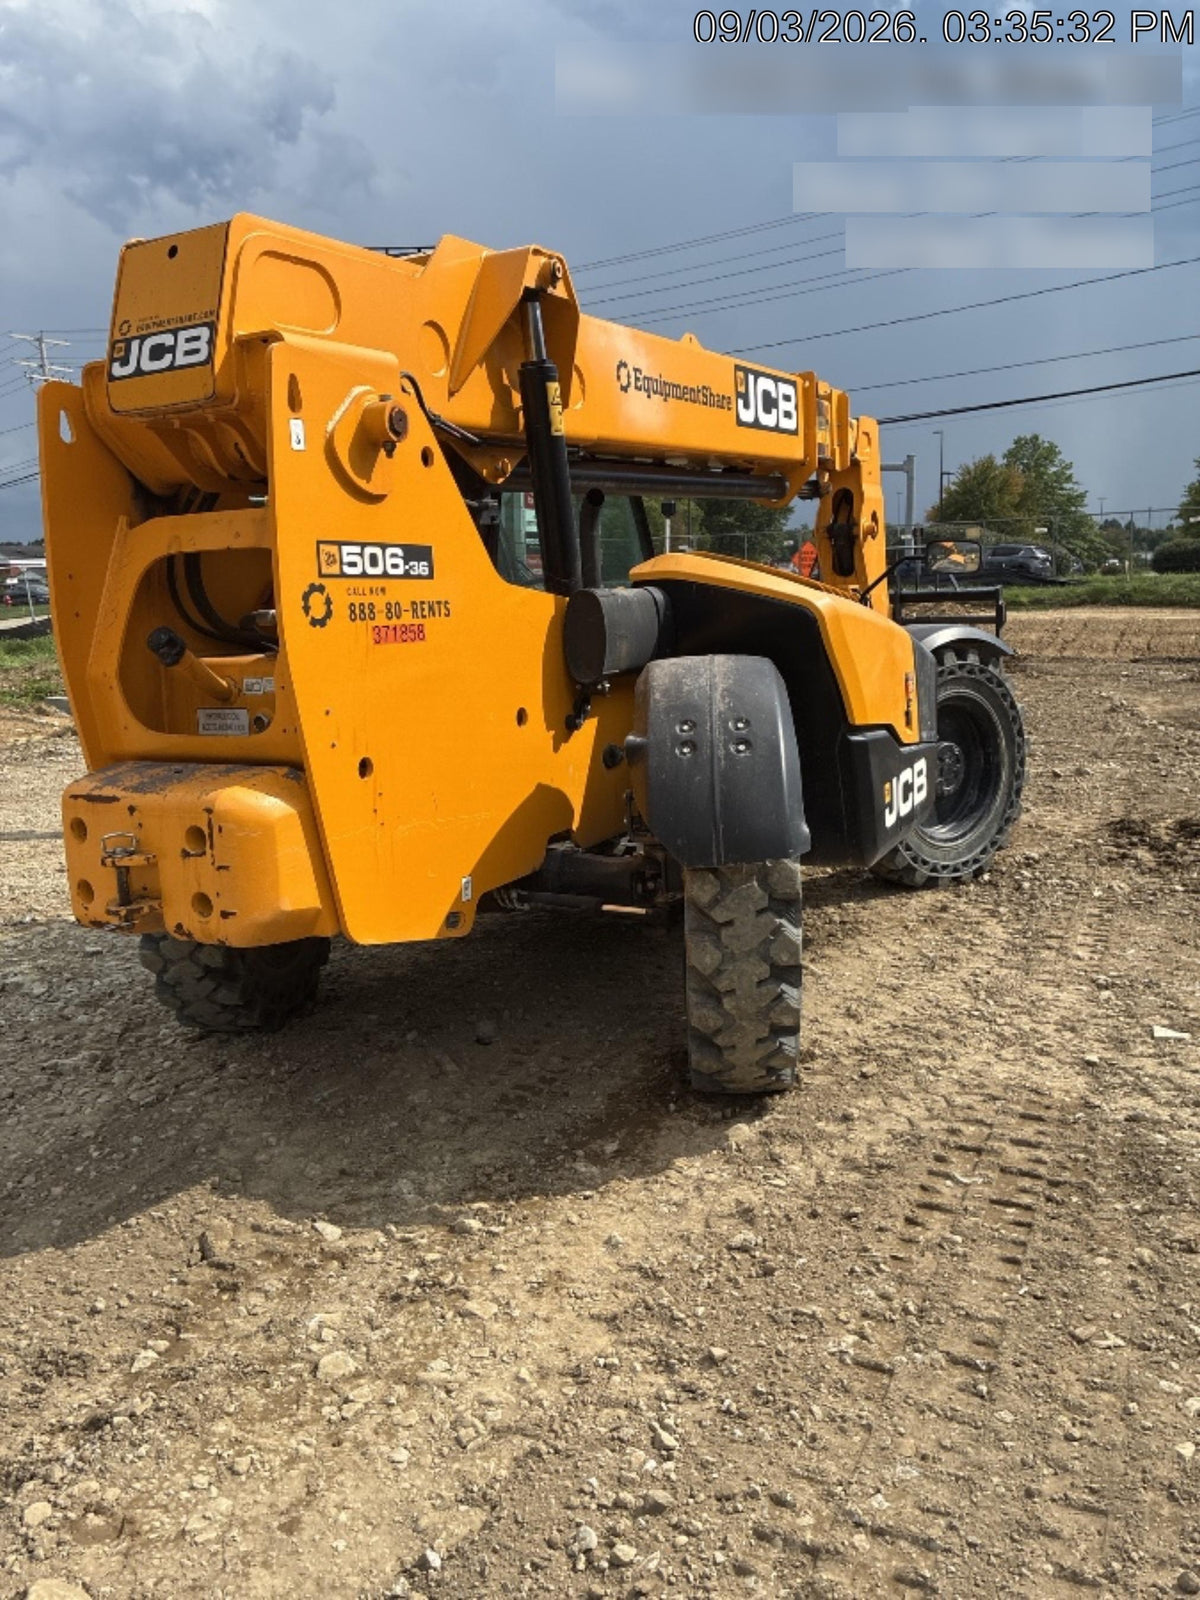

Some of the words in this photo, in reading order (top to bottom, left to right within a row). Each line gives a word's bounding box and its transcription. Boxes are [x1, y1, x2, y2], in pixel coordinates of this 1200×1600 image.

[111, 326, 211, 377] JCB
[633, 366, 733, 411] EquipmentShare
[737, 372, 797, 431] JCB
[346, 586, 367, 597] CALL
[372, 624, 426, 644] 371858
[884, 756, 928, 828] JCB
